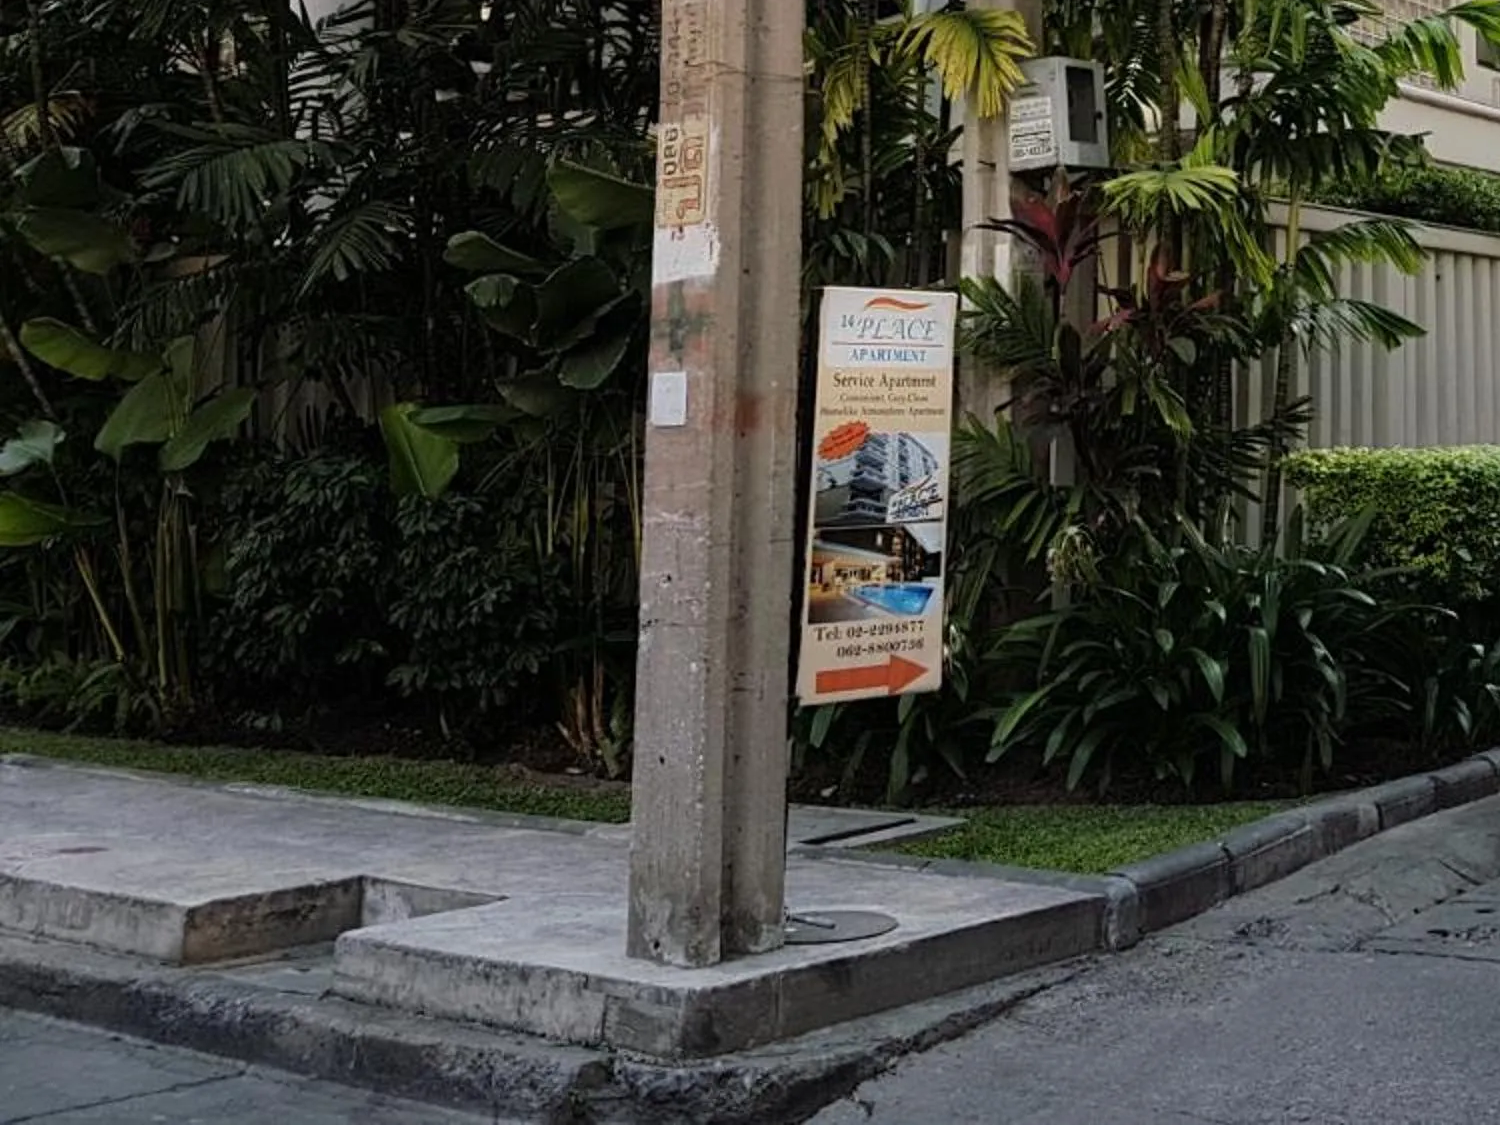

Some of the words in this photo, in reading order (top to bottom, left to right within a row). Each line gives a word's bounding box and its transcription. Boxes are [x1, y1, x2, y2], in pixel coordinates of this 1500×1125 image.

[849, 349, 926, 362] APARTMENT
[833, 373, 875, 387] Service
[880, 374, 936, 391] Apartment
